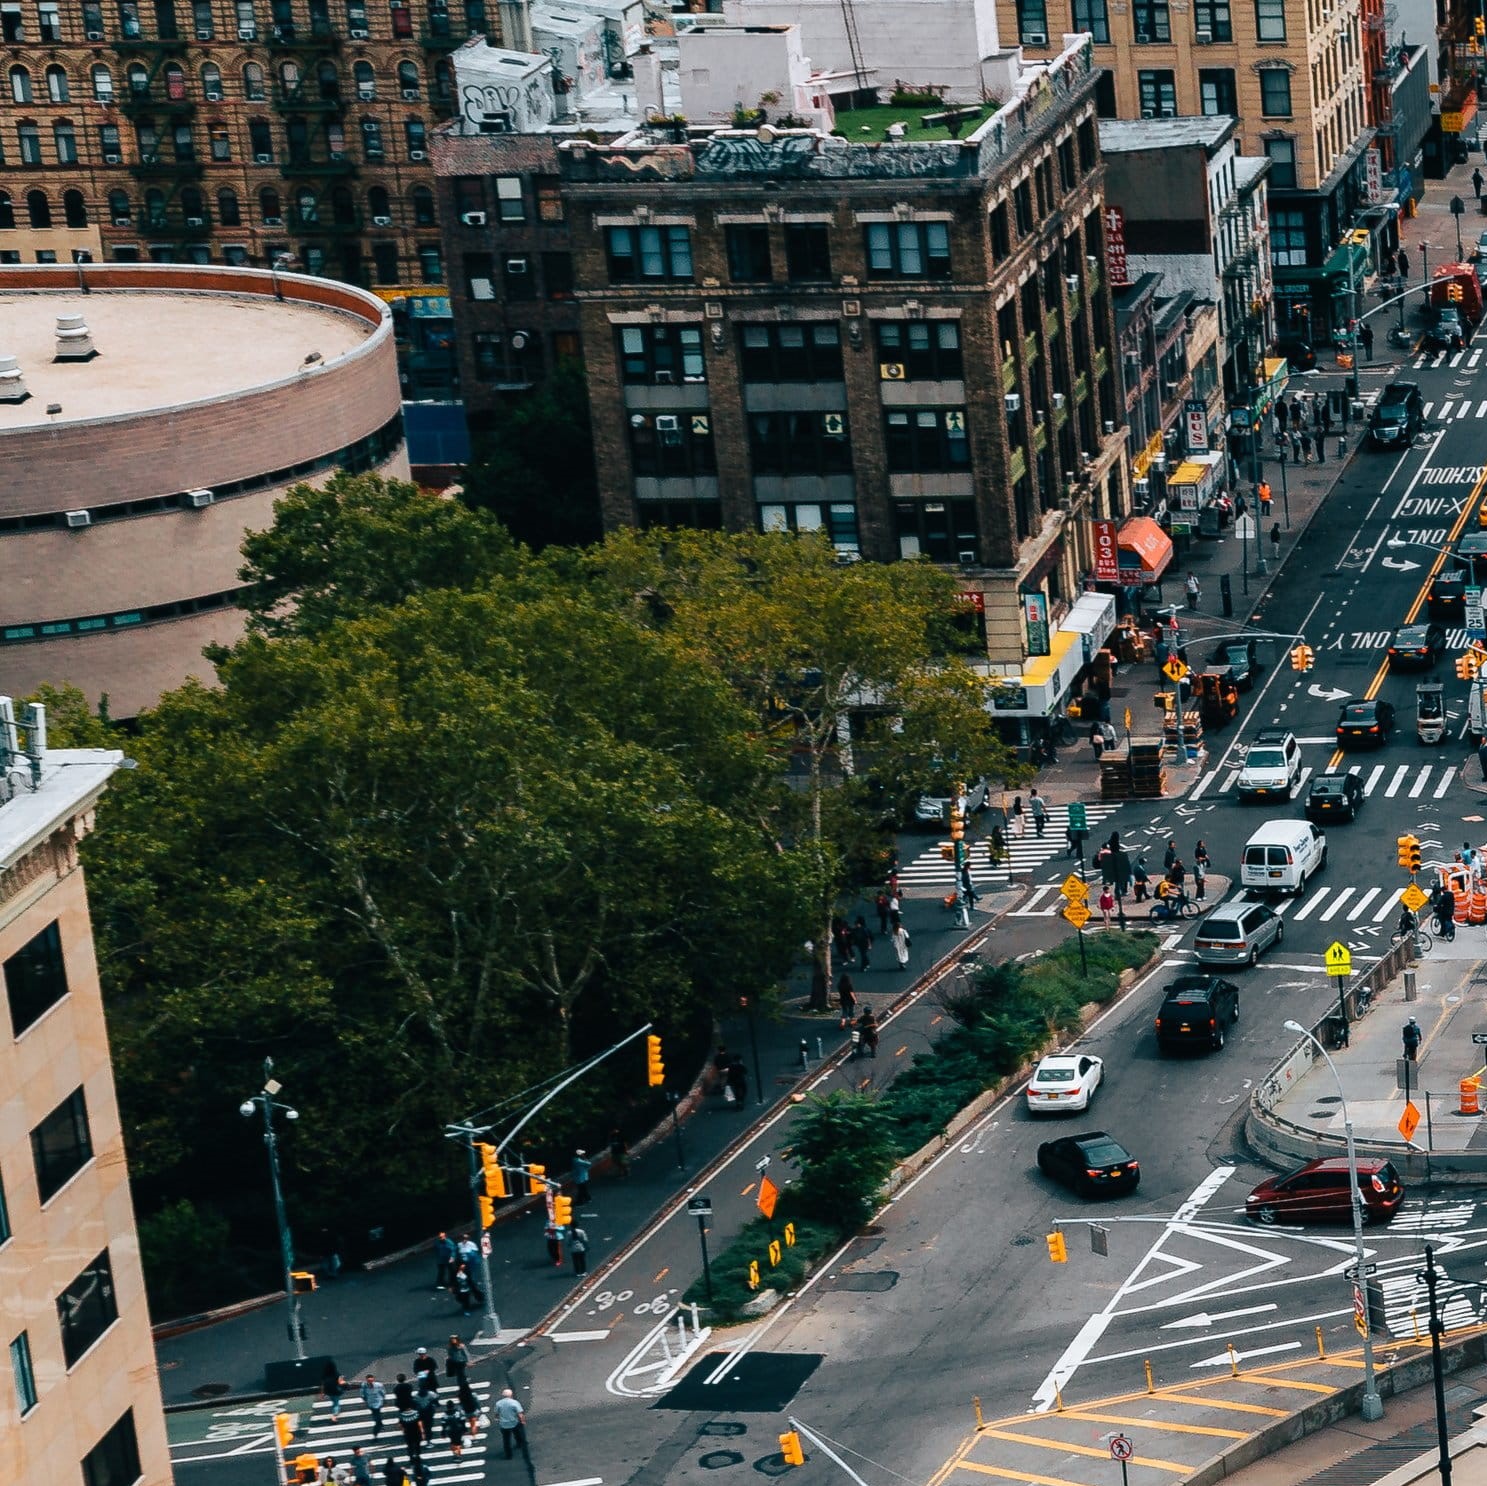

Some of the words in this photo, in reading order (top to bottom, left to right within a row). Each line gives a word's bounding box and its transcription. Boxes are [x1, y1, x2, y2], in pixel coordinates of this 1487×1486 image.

[1190, 413, 1204, 442] BUS
[1422, 466, 1487, 485] SCHOOL
[1400, 497, 1469, 516] X-ING
[1099, 524, 1112, 559] 103
[1468, 619, 1483, 628] 25
[1327, 632, 1391, 650] ONLY
